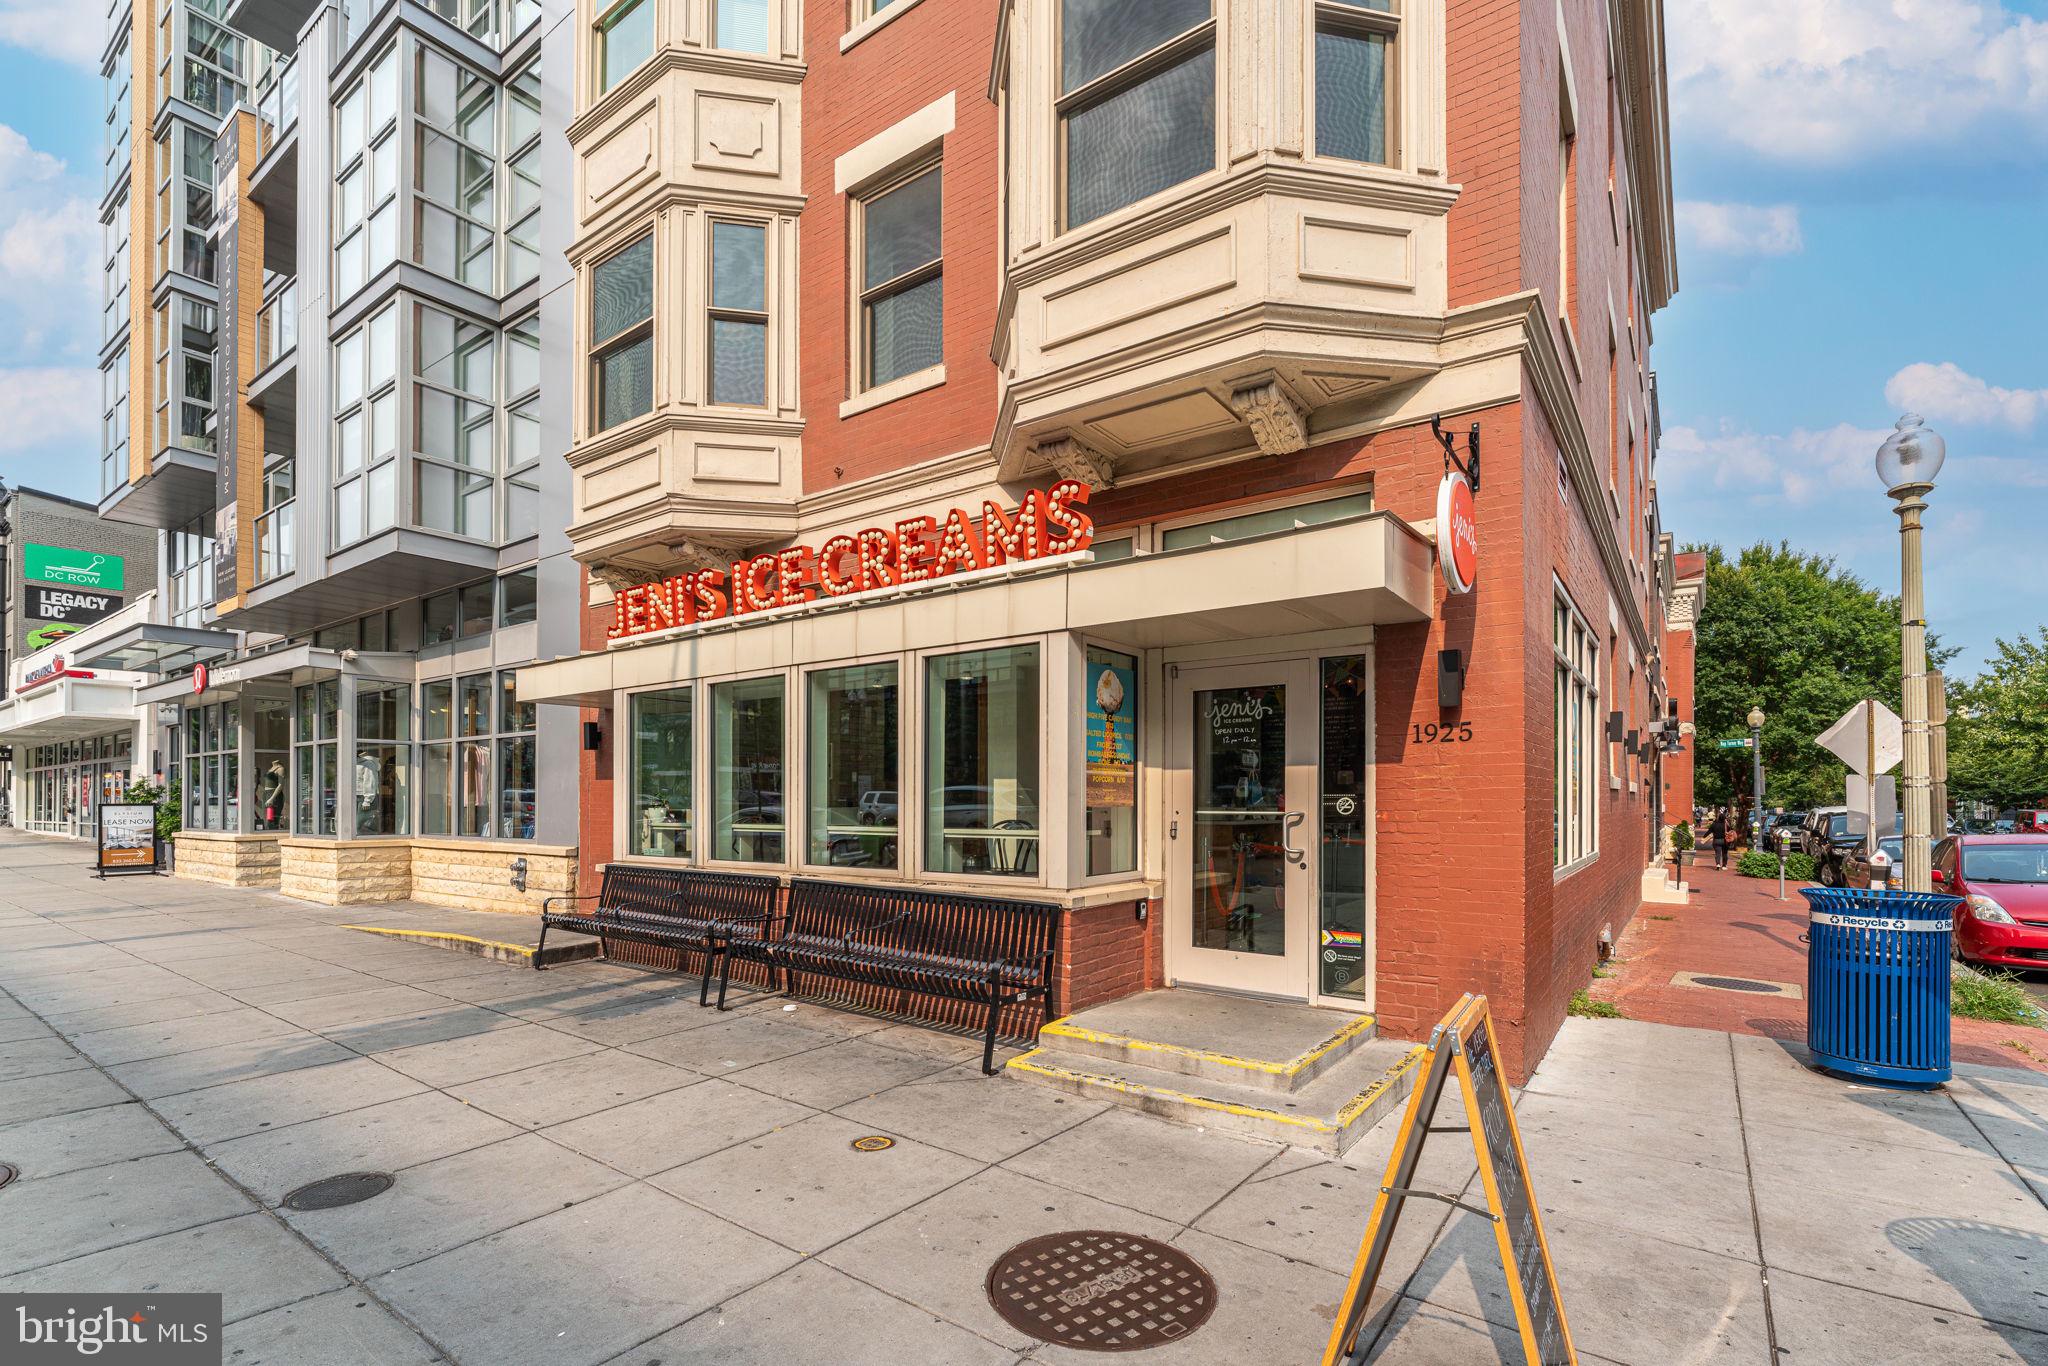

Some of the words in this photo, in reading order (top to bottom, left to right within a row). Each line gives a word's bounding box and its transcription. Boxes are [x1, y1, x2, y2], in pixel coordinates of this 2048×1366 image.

[732, 545, 816, 616] ICE
[818, 479, 1095, 597] CREAMS
[44, 569, 64, 580] DC
[68, 573, 100, 584] ROW
[40, 590, 109, 611] LEGACY
[1204, 696, 1273, 727] jeni's
[1413, 721, 1473, 743] 1925
[1842, 916, 1889, 928] Recycle
